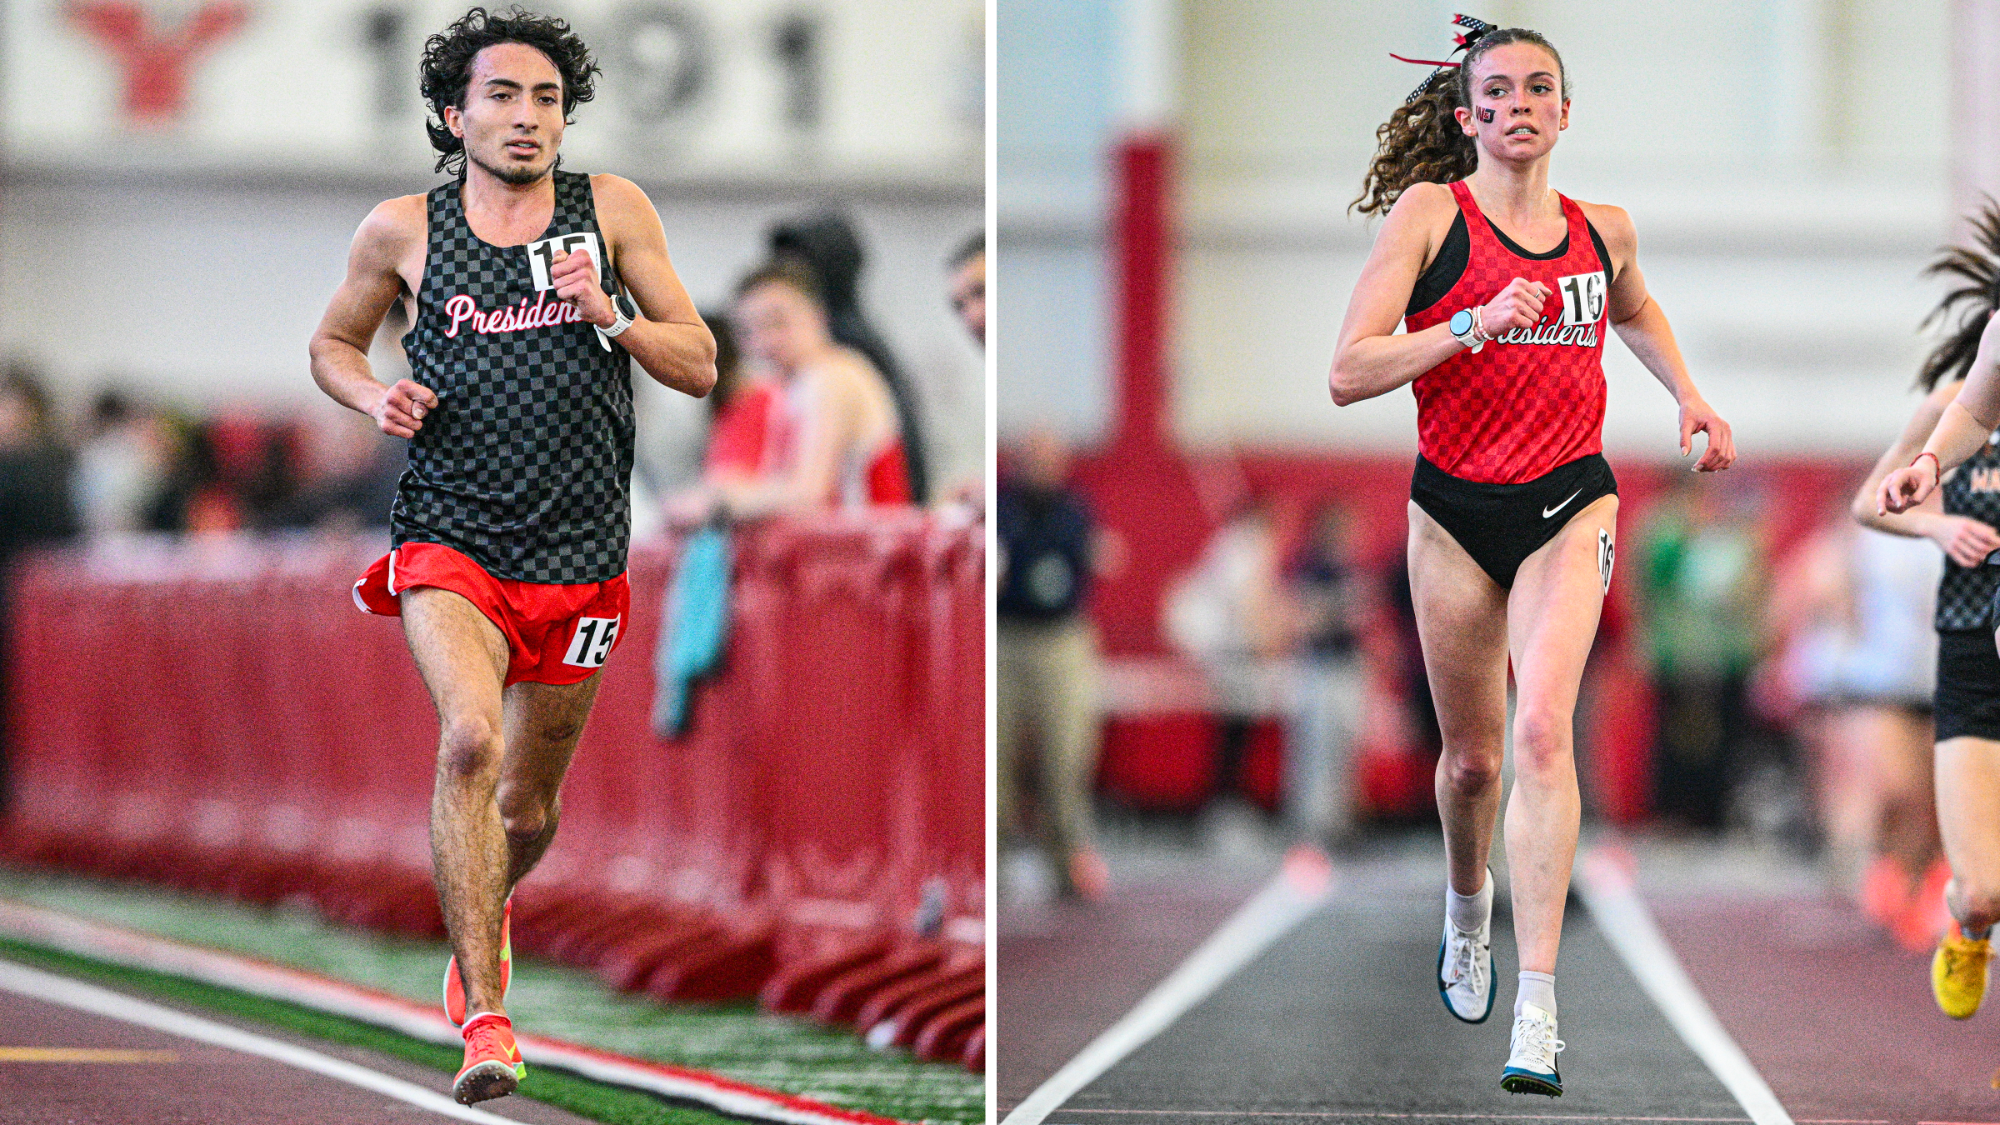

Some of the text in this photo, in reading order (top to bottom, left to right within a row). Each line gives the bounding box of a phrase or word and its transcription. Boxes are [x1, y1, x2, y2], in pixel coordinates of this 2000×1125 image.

[534, 236, 586, 287] 1
[444, 290, 582, 339] Presiden
[1564, 274, 1603, 323] 16
[1600, 533, 1613, 588] 16
[576, 619, 618, 665] 15
